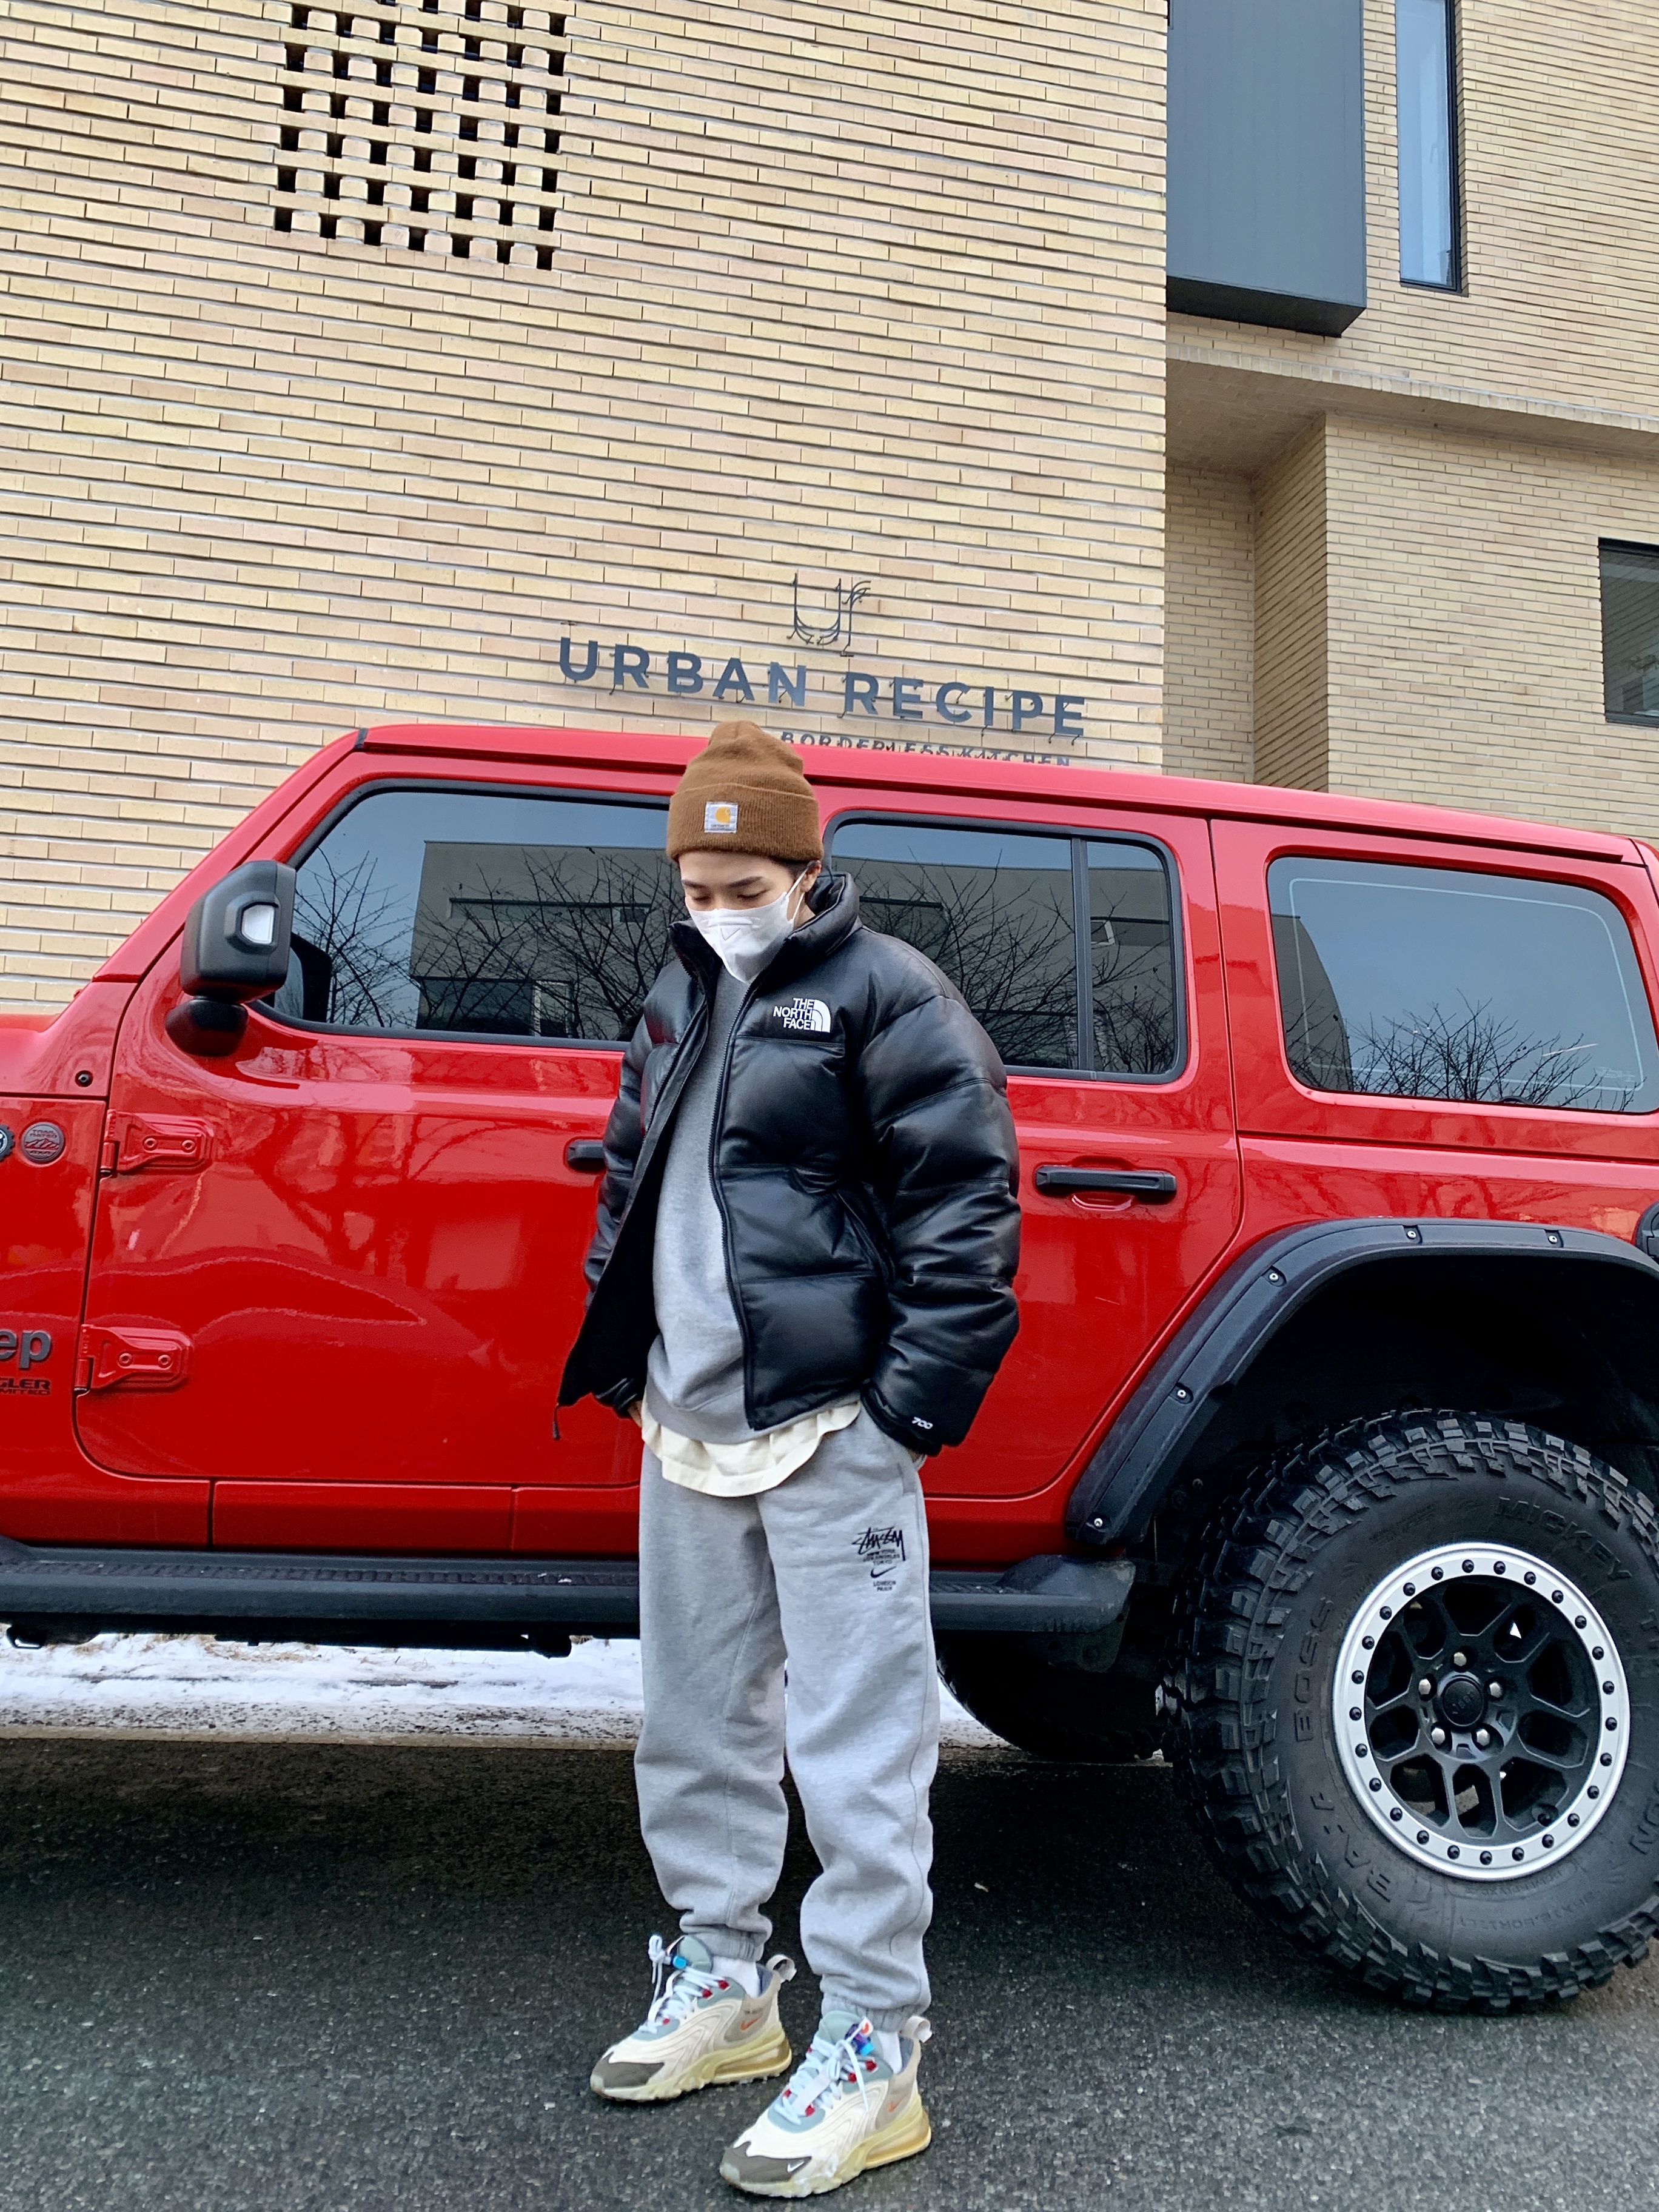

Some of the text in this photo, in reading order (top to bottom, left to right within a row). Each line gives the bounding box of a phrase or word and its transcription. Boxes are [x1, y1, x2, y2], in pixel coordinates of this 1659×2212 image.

[559, 637, 1085, 737] URBAN RECIPE
[793, 997, 815, 1010] THE
[773, 1006, 813, 1020] NORTH
[783, 1017, 811, 1030] FACE
